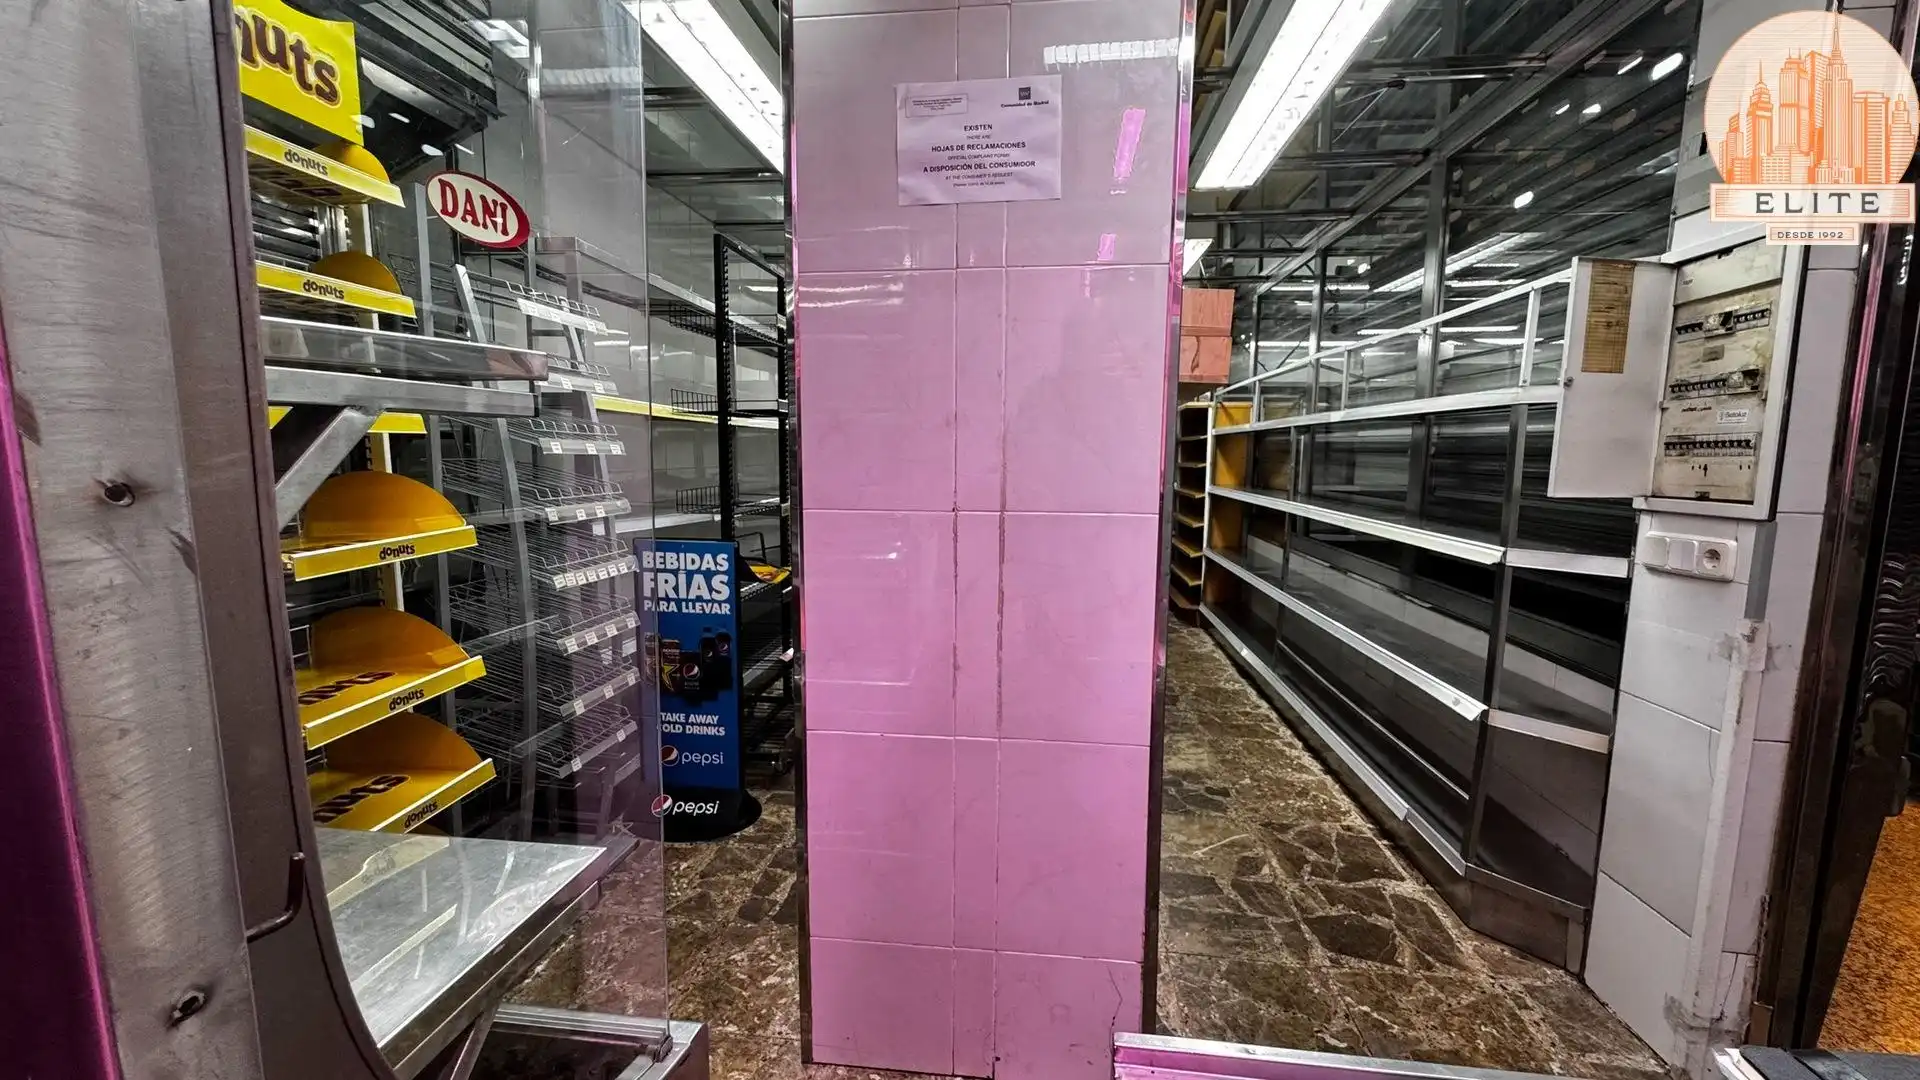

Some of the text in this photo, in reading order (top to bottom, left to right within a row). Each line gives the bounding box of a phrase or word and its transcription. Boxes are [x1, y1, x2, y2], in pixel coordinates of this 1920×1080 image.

[963, 124, 993, 132] EXISTEN
[931, 144, 955, 152] HOJAS
[967, 141, 1026, 151] RECLAMACIONES
[284, 149, 328, 176] donuts
[929, 163, 973, 173] DISPOSICIÓN
[988, 160, 1036, 169] CONSUMIDOR
[438, 178, 509, 236] DANI
[303, 279, 345, 300] donuts
[379, 543, 416, 560] donuts
[642, 551, 729, 572] BEBIDAS
[643, 570, 730, 601] FRÍAS
[643, 600, 731, 615] PARA LLEVAR
[388, 687, 425, 712] donuts
[660, 712, 720, 725] TAKE AWAY
[685, 725, 726, 737] DRINKS
[681, 751, 724, 767] pepsi
[404, 800, 439, 829] donuts
[672, 800, 720, 817] pepsi
